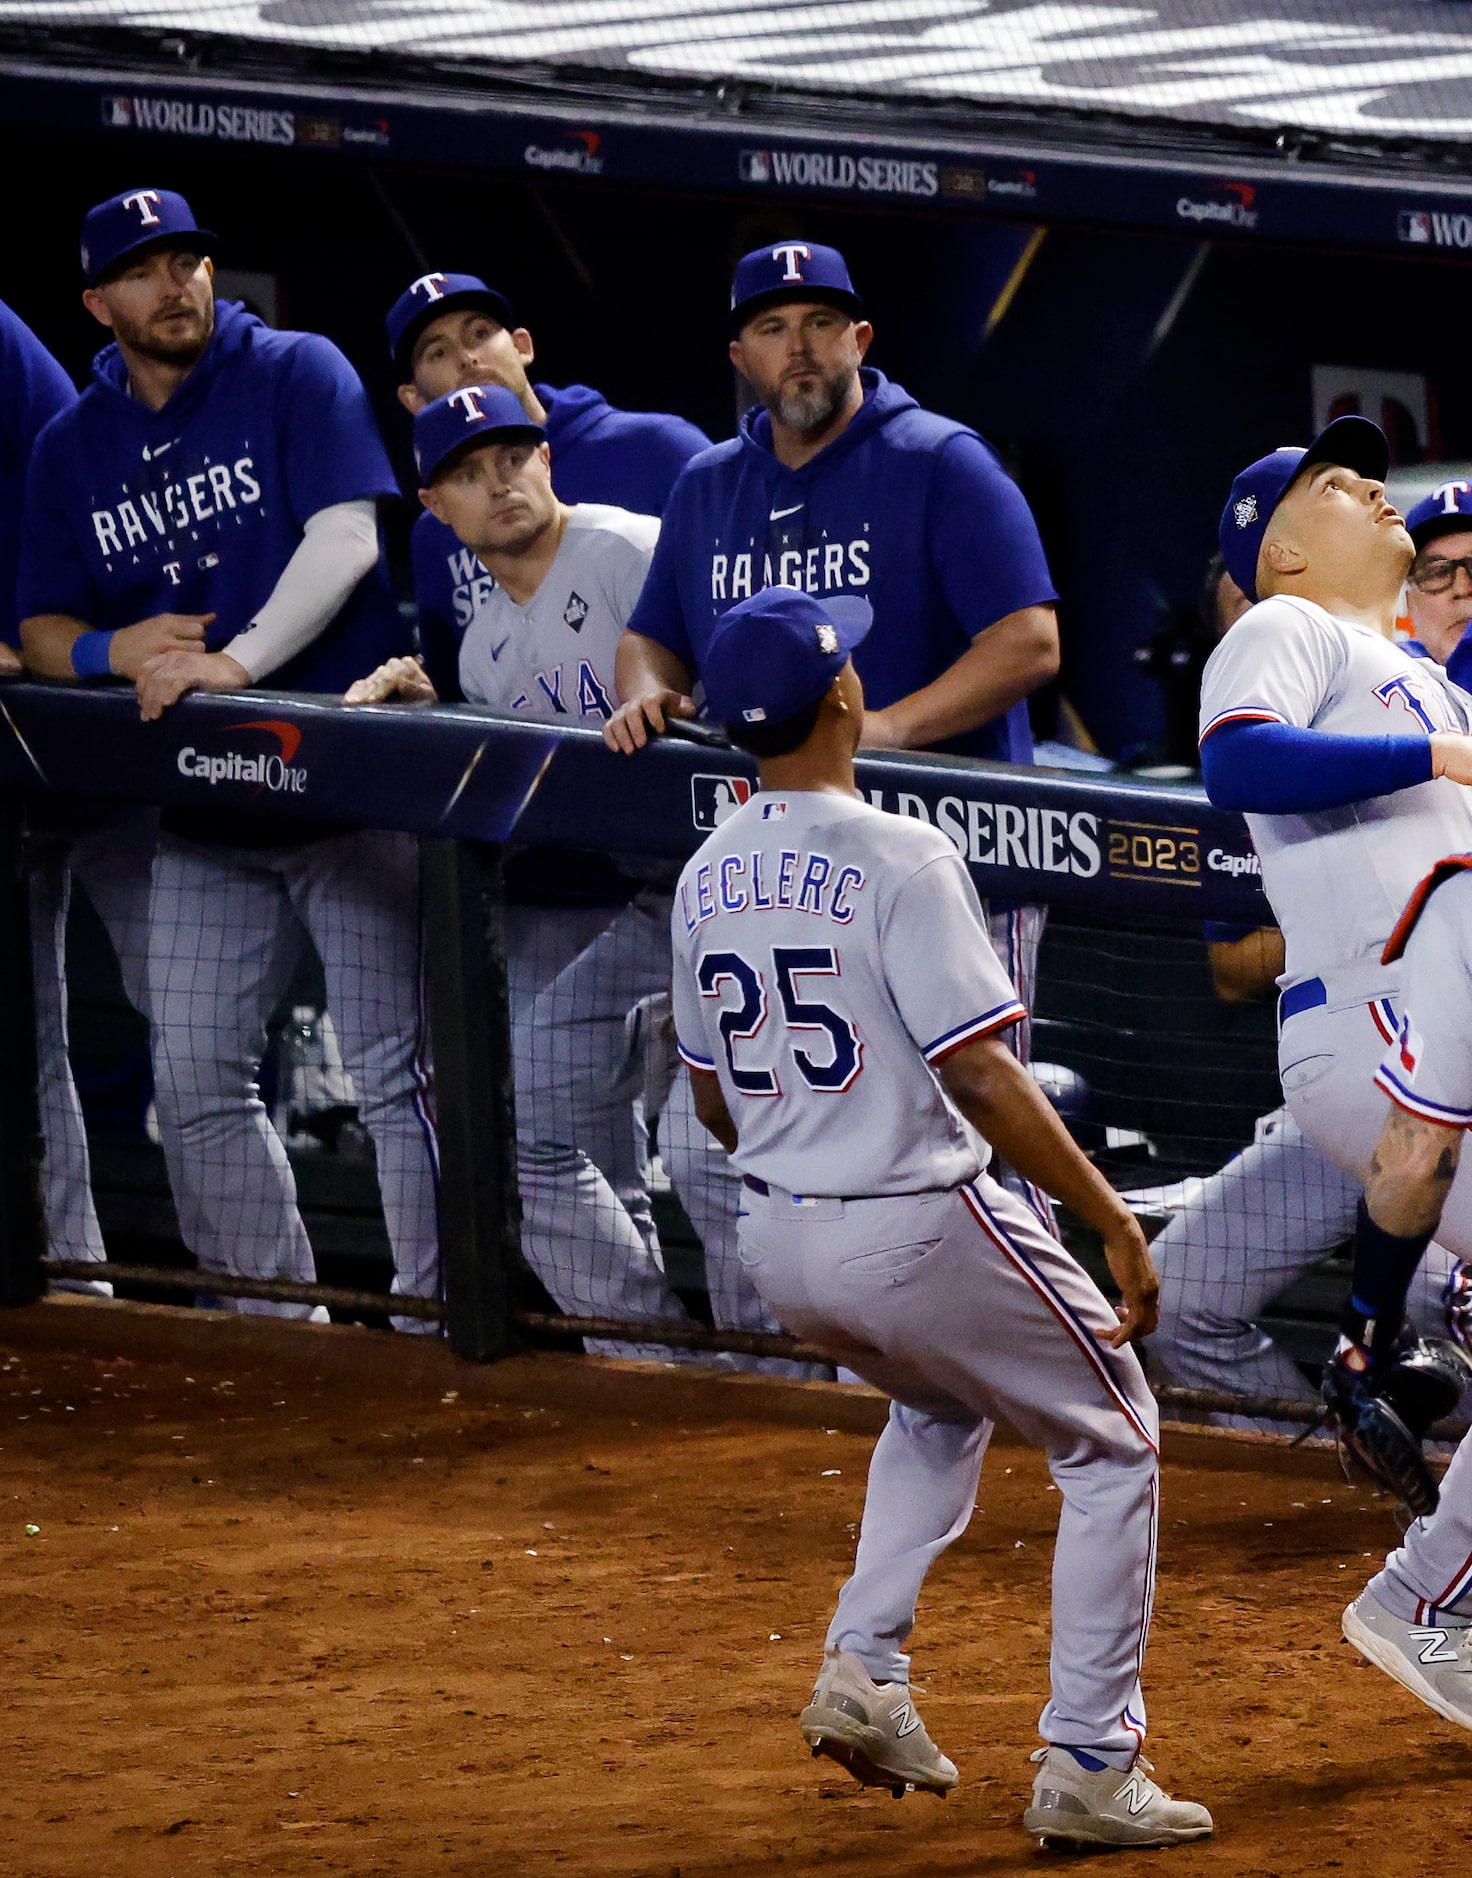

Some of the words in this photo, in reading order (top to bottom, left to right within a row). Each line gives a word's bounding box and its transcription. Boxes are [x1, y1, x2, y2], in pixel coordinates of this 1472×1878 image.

[133, 98, 215, 135] WORLD
[216, 105, 295, 145] SERIES
[771, 152, 855, 188] WORLD
[857, 157, 938, 196] SERIES
[122, 190, 162, 226] T
[772, 245, 812, 282] T
[409, 272, 446, 303] T
[447, 386, 483, 424] T
[163, 562, 182, 585] T
[711, 539, 871, 600] RANGERS
[936, 791, 1102, 879] SERIES
[1108, 833, 1200, 873] 2023
[680, 849, 866, 938] LECLERC
[696, 944, 864, 1096] 25
